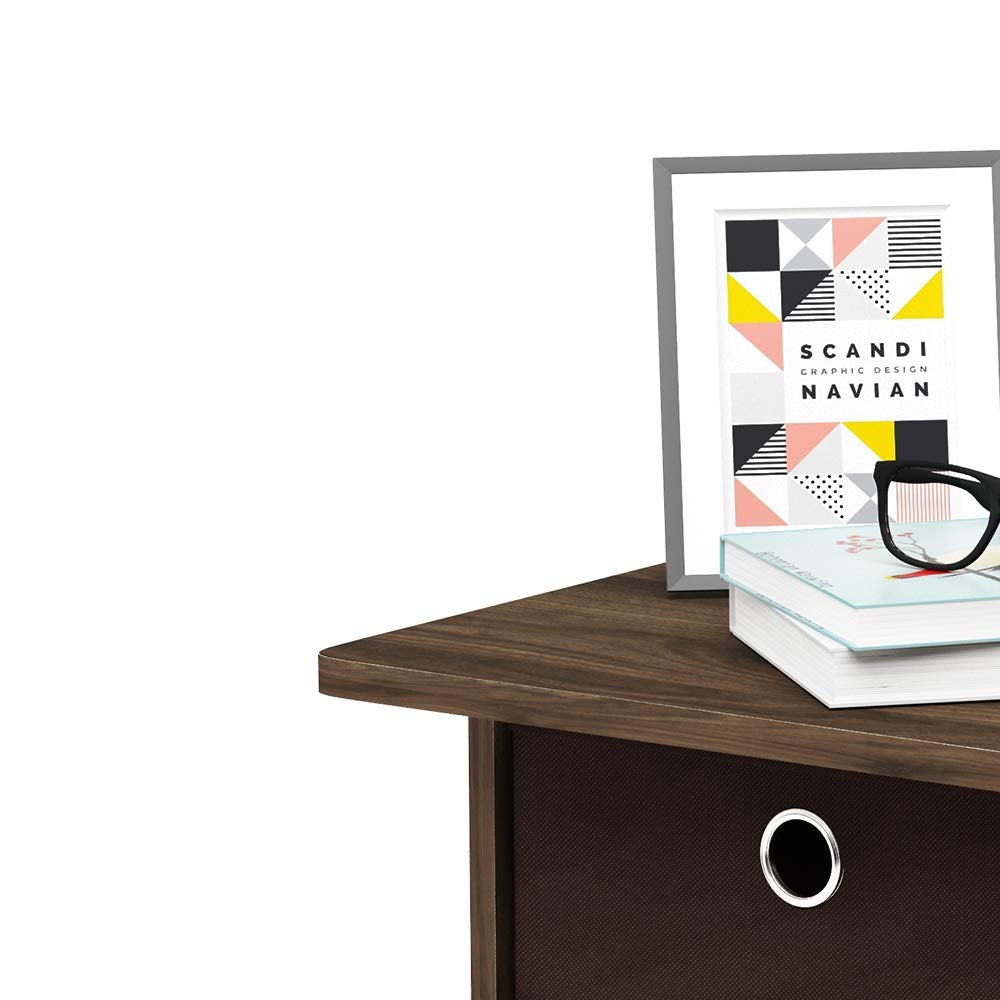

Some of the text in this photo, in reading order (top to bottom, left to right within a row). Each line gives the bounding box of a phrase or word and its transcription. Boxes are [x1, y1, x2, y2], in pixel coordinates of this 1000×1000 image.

[800, 341, 926, 359] SCANDI
[801, 365, 928, 375] GRAPHIC DESIGN
[802, 382, 929, 399] NAVIAN
